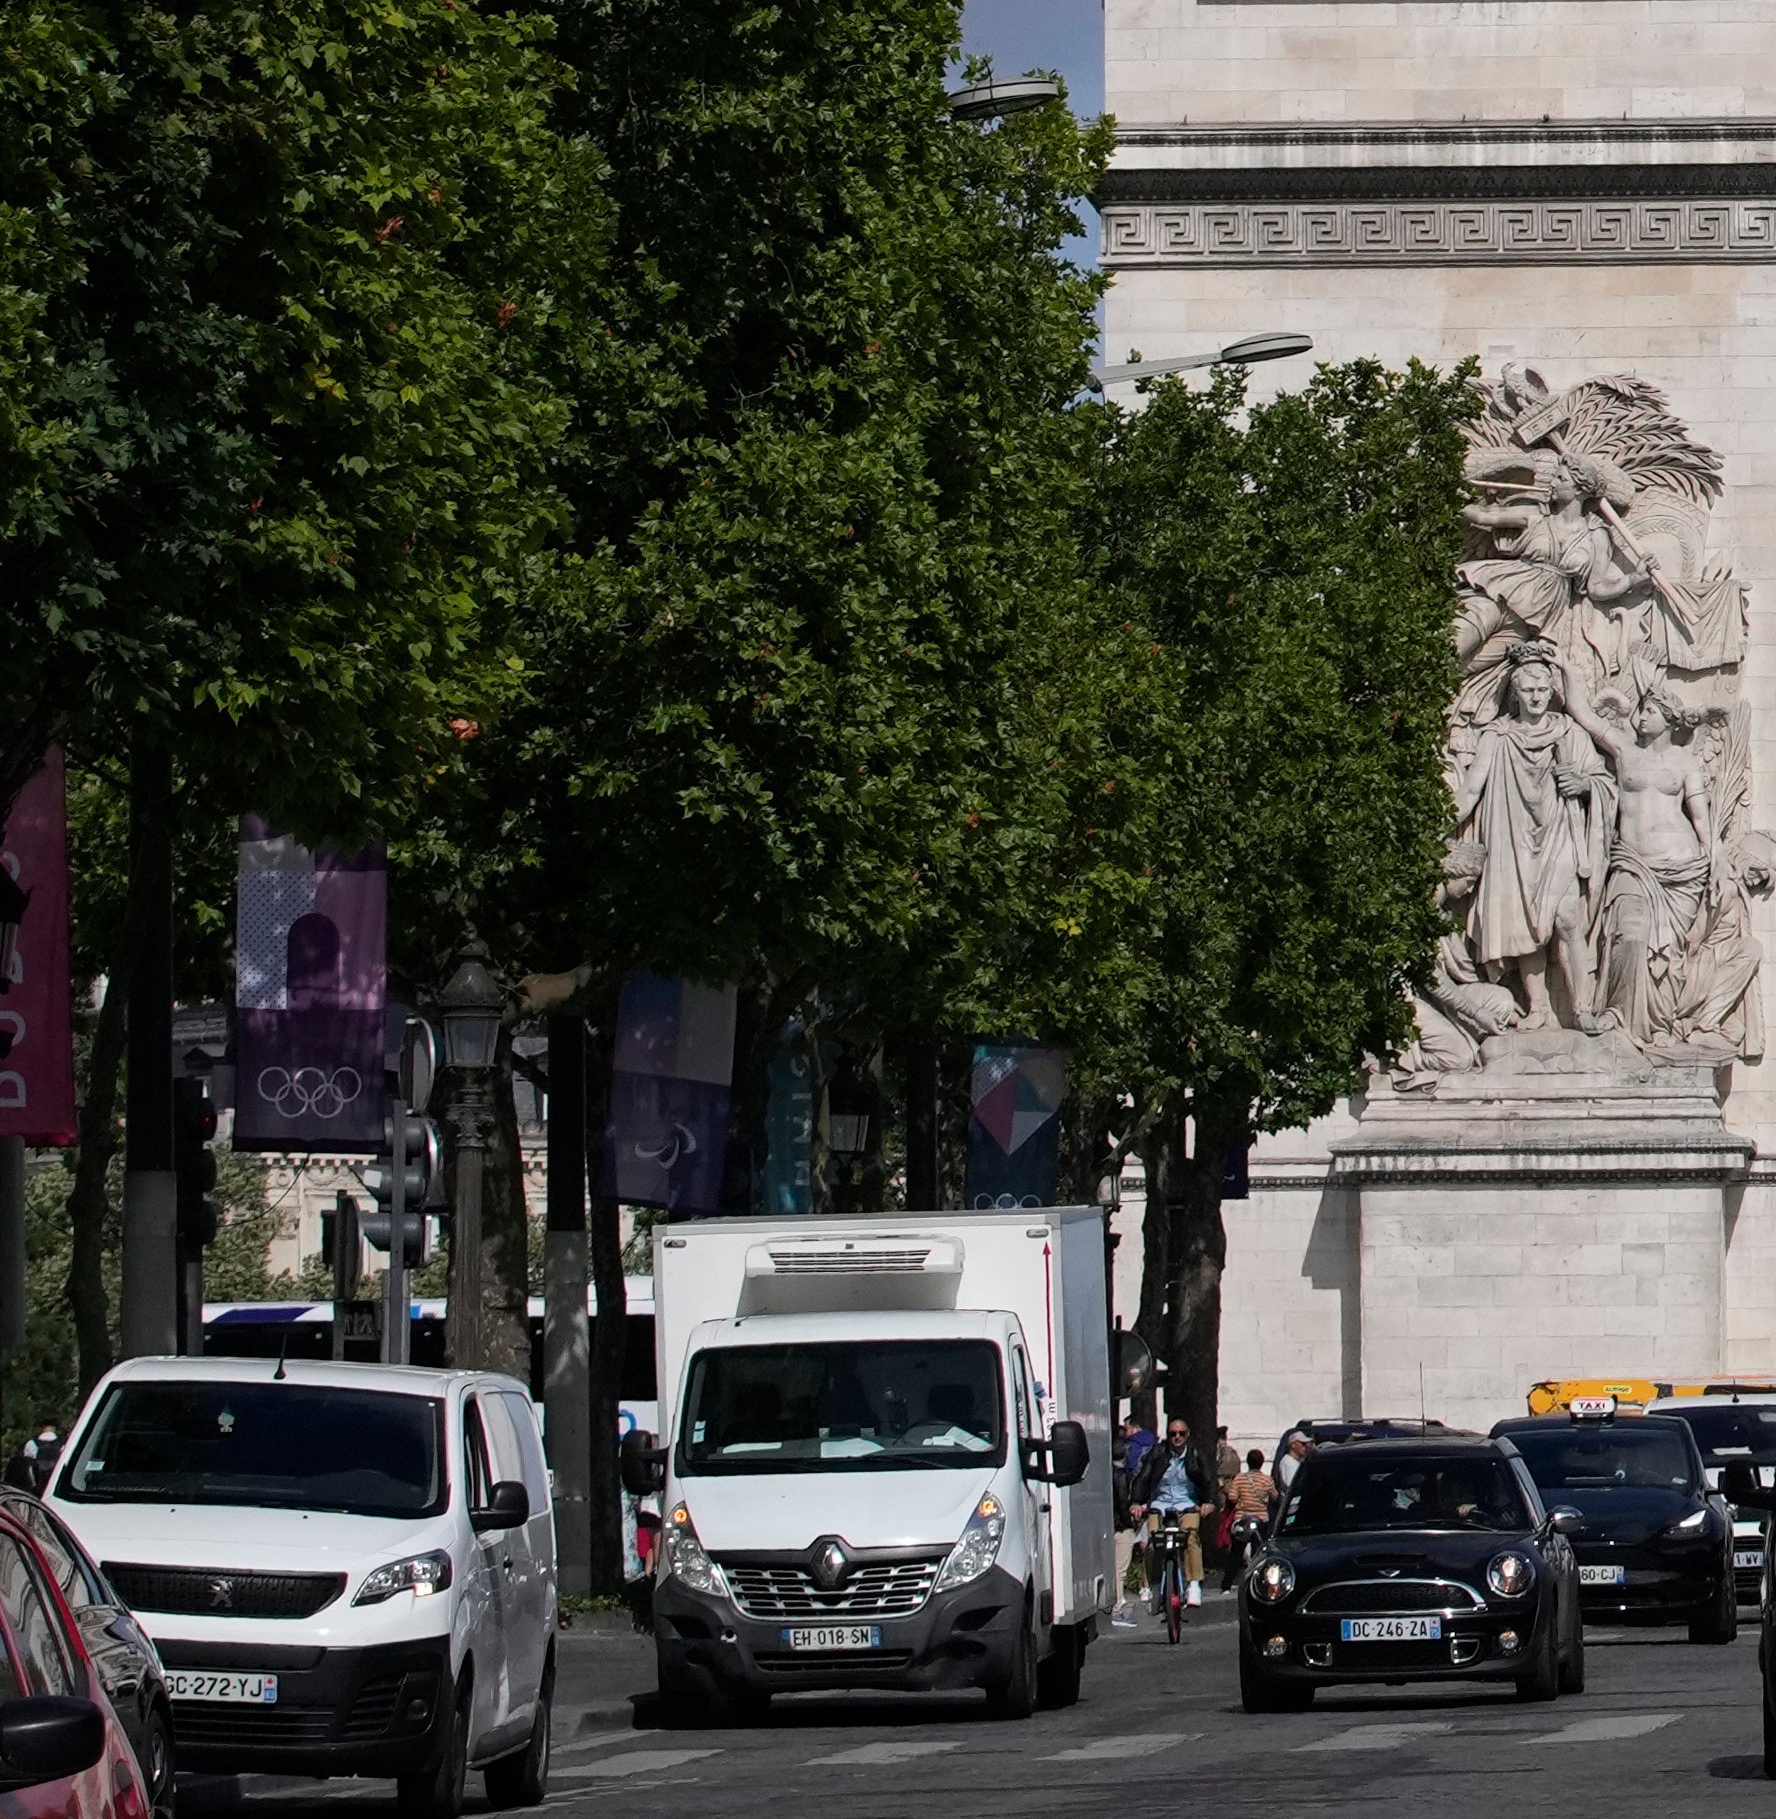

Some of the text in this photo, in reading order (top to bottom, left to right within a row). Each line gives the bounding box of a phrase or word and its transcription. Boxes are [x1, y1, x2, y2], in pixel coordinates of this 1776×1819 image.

[1578, 1401, 1605, 1409] TAXI
[793, 1628, 869, 1646] EH-018-SN
[1352, 1621, 1428, 1638] DC-246-ZA
